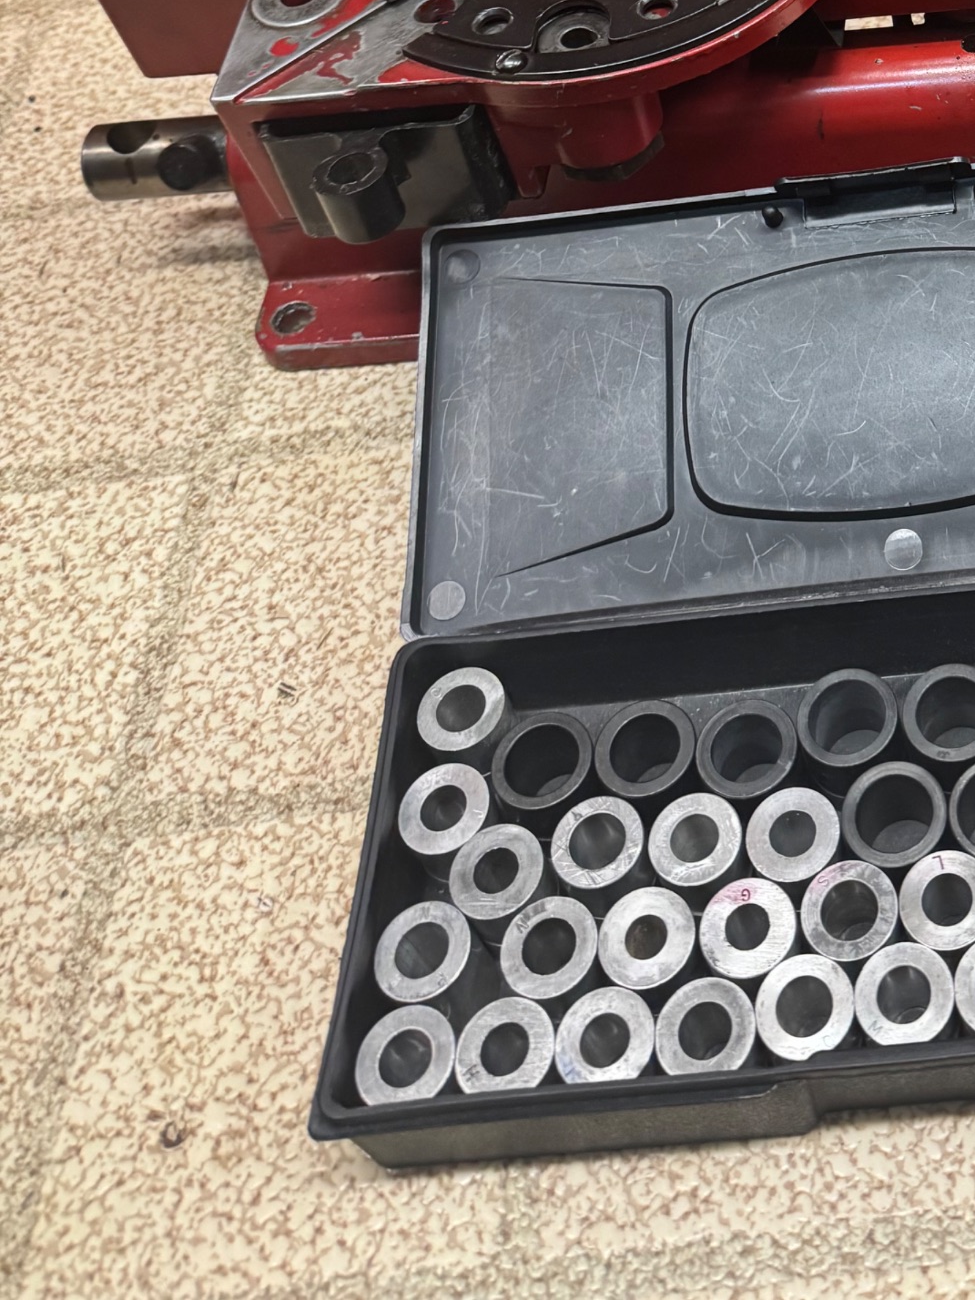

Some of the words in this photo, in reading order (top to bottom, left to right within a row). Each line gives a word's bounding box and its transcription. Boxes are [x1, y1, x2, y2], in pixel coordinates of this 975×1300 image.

[932, 855, 945, 870] L
[818, 875, 830, 887] S
[740, 888, 751, 901] G
